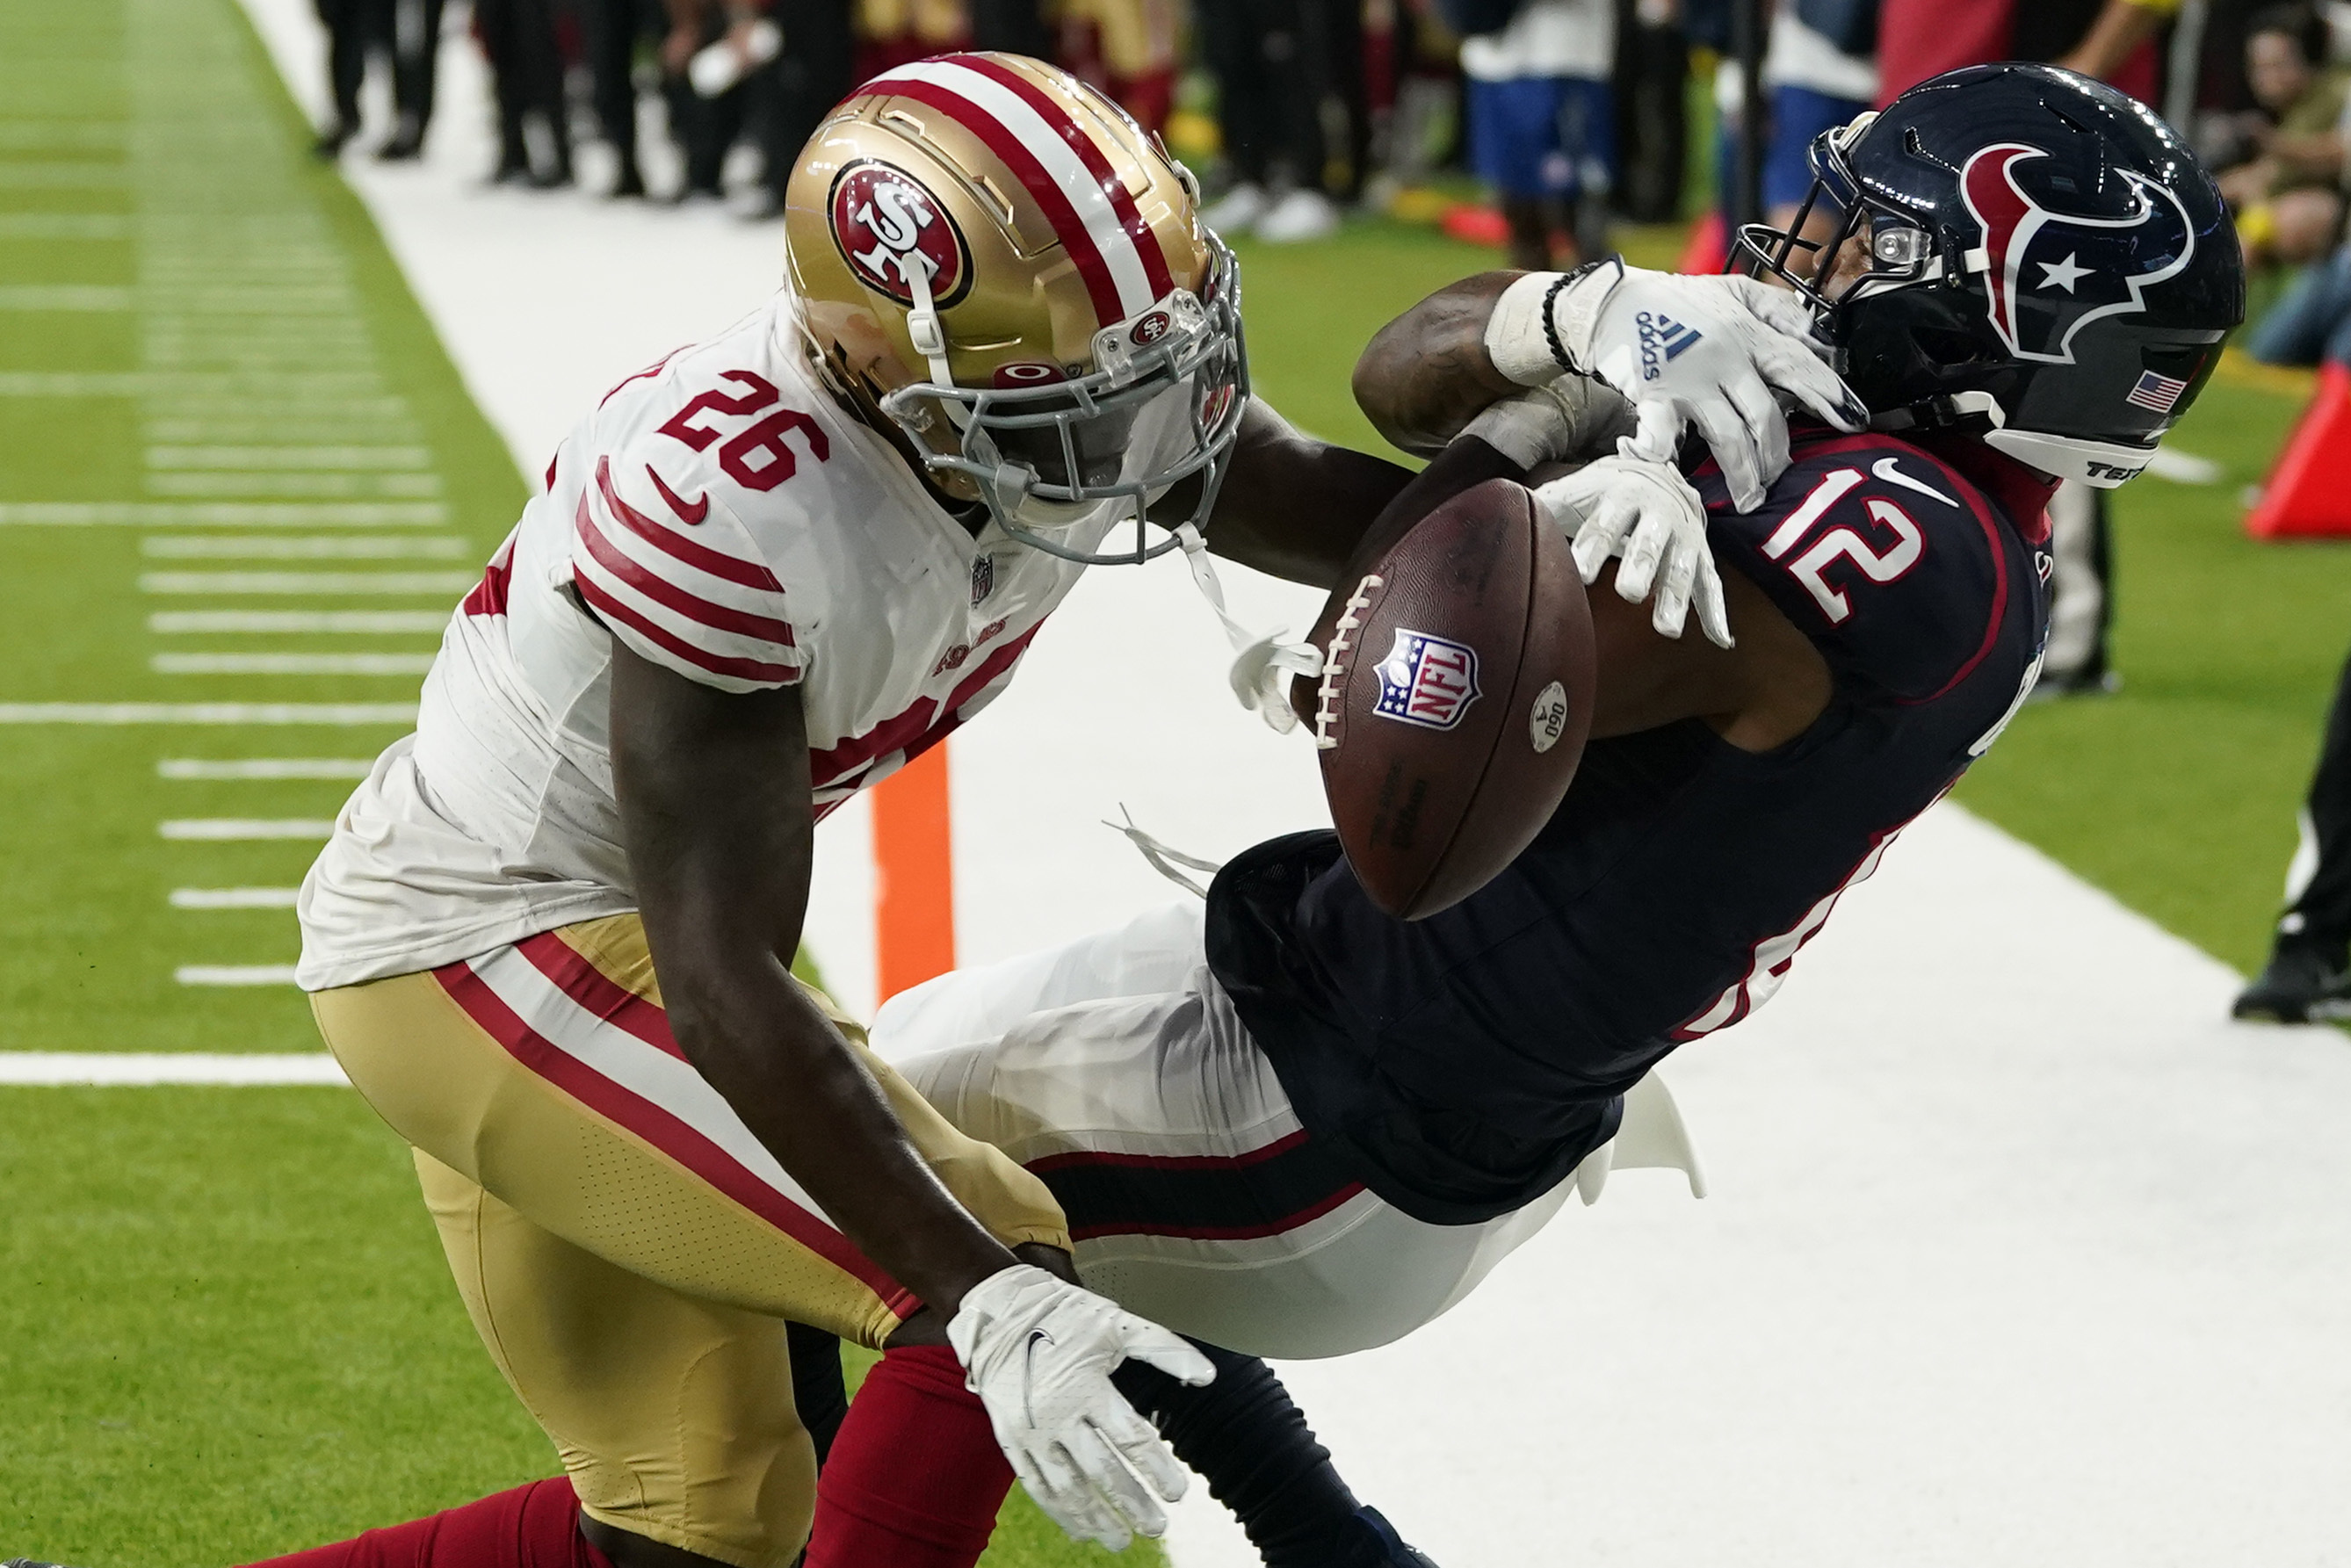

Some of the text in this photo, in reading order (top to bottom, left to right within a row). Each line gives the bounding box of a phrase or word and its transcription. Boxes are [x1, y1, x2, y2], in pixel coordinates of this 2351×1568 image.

[1636, 311, 1661, 381] adidas
[655, 370, 830, 492] 26
[1757, 466, 1928, 629] 12
[1411, 653, 1467, 721] NFL
[1544, 702, 1565, 738] 090
